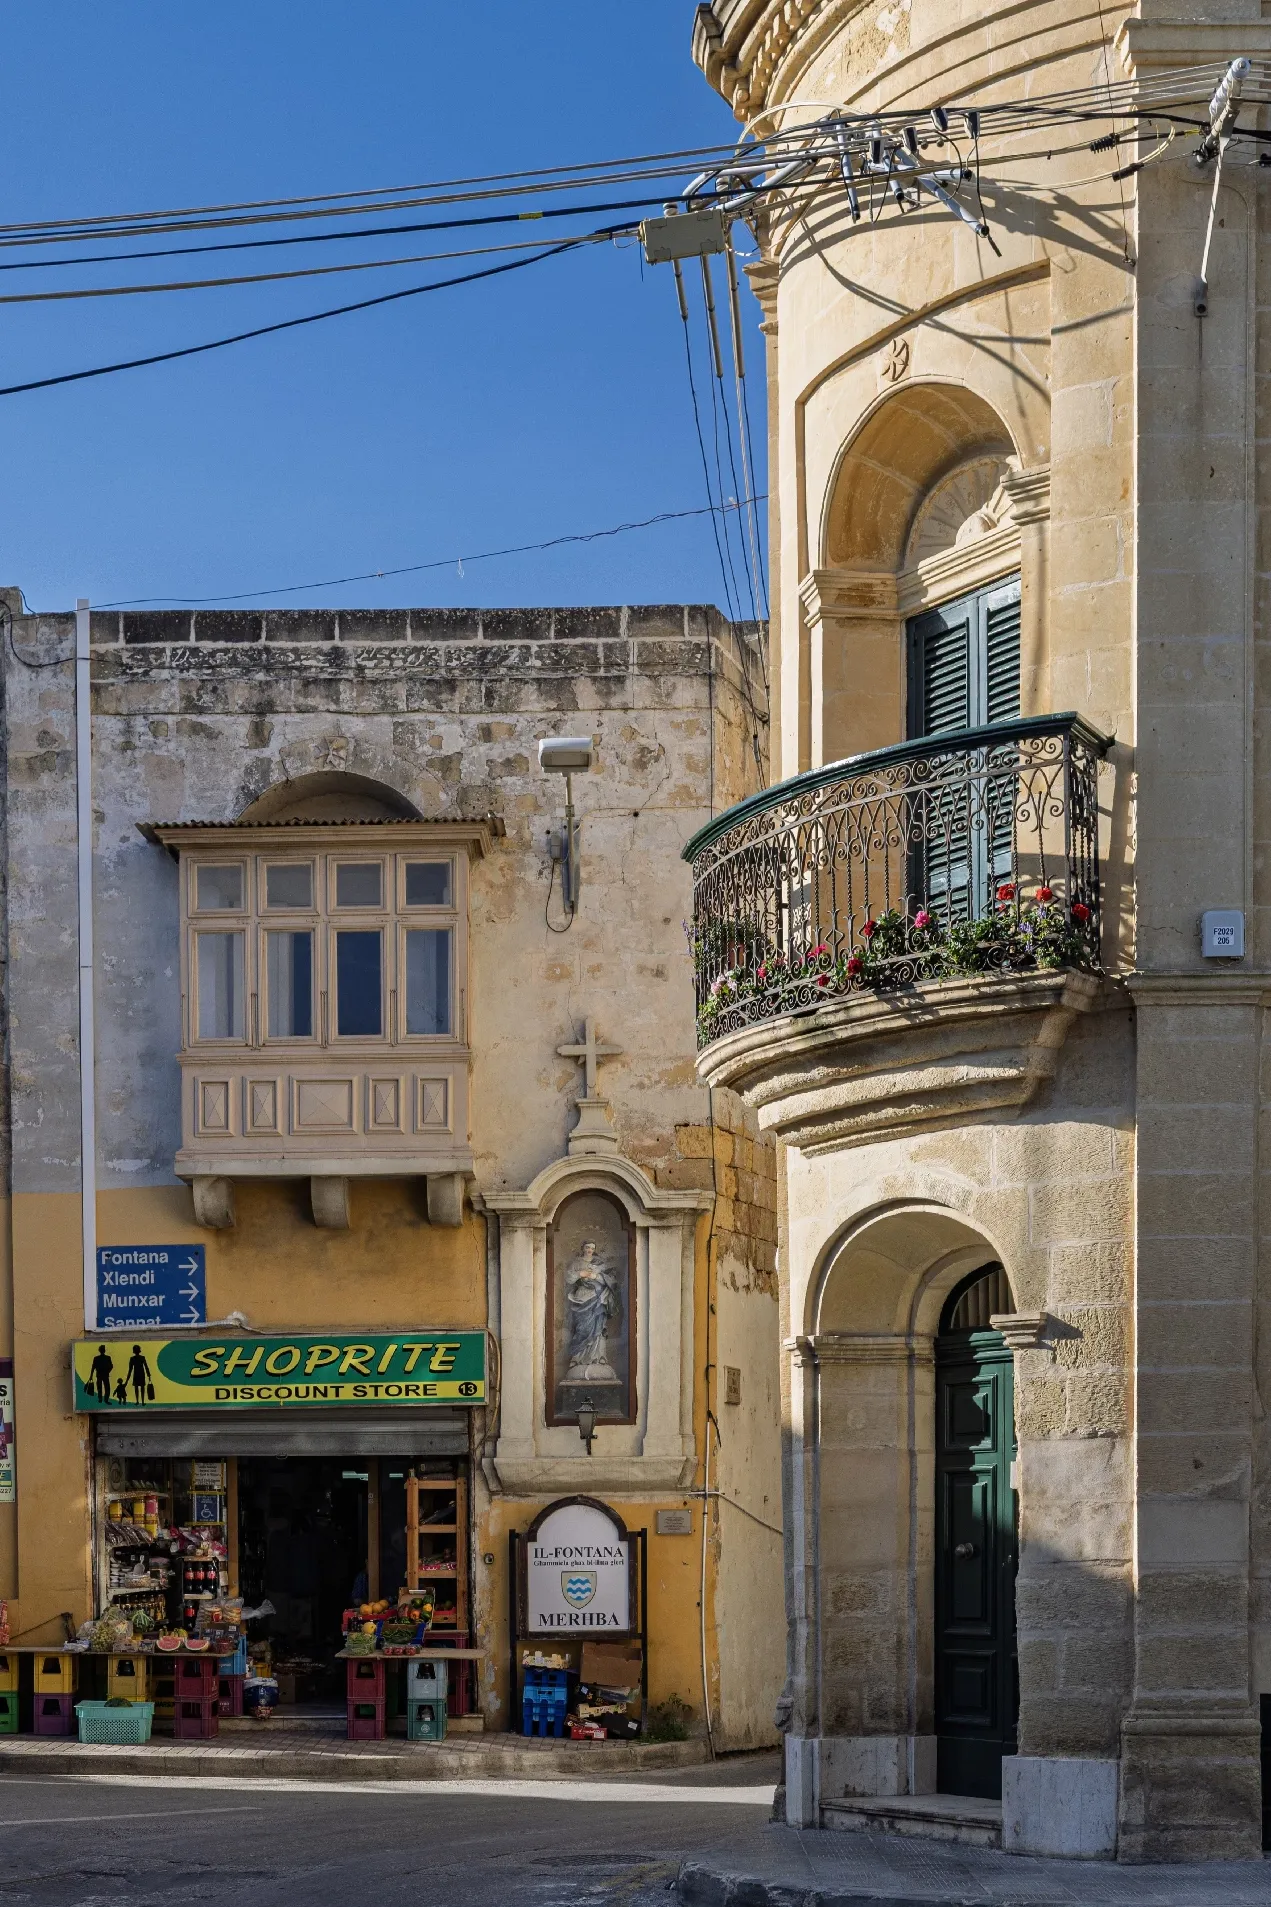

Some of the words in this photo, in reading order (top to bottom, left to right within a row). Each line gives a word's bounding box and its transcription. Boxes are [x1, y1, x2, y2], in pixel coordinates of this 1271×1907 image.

[1213, 927, 1234, 935] F2029
[101, 1251, 169, 1265] Fontana
[103, 1270, 155, 1286] Xlendi
[103, 1293, 166, 1308] Munxar
[190, 1342, 461, 1378] SHOPRITE
[215, 1385, 344, 1400] DISCOUNT
[352, 1383, 438, 1398] STORE
[460, 1383, 475, 1395] 13
[533, 1546, 624, 1559] IL-FONTANA
[537, 1612, 621, 1627] MERHBA
